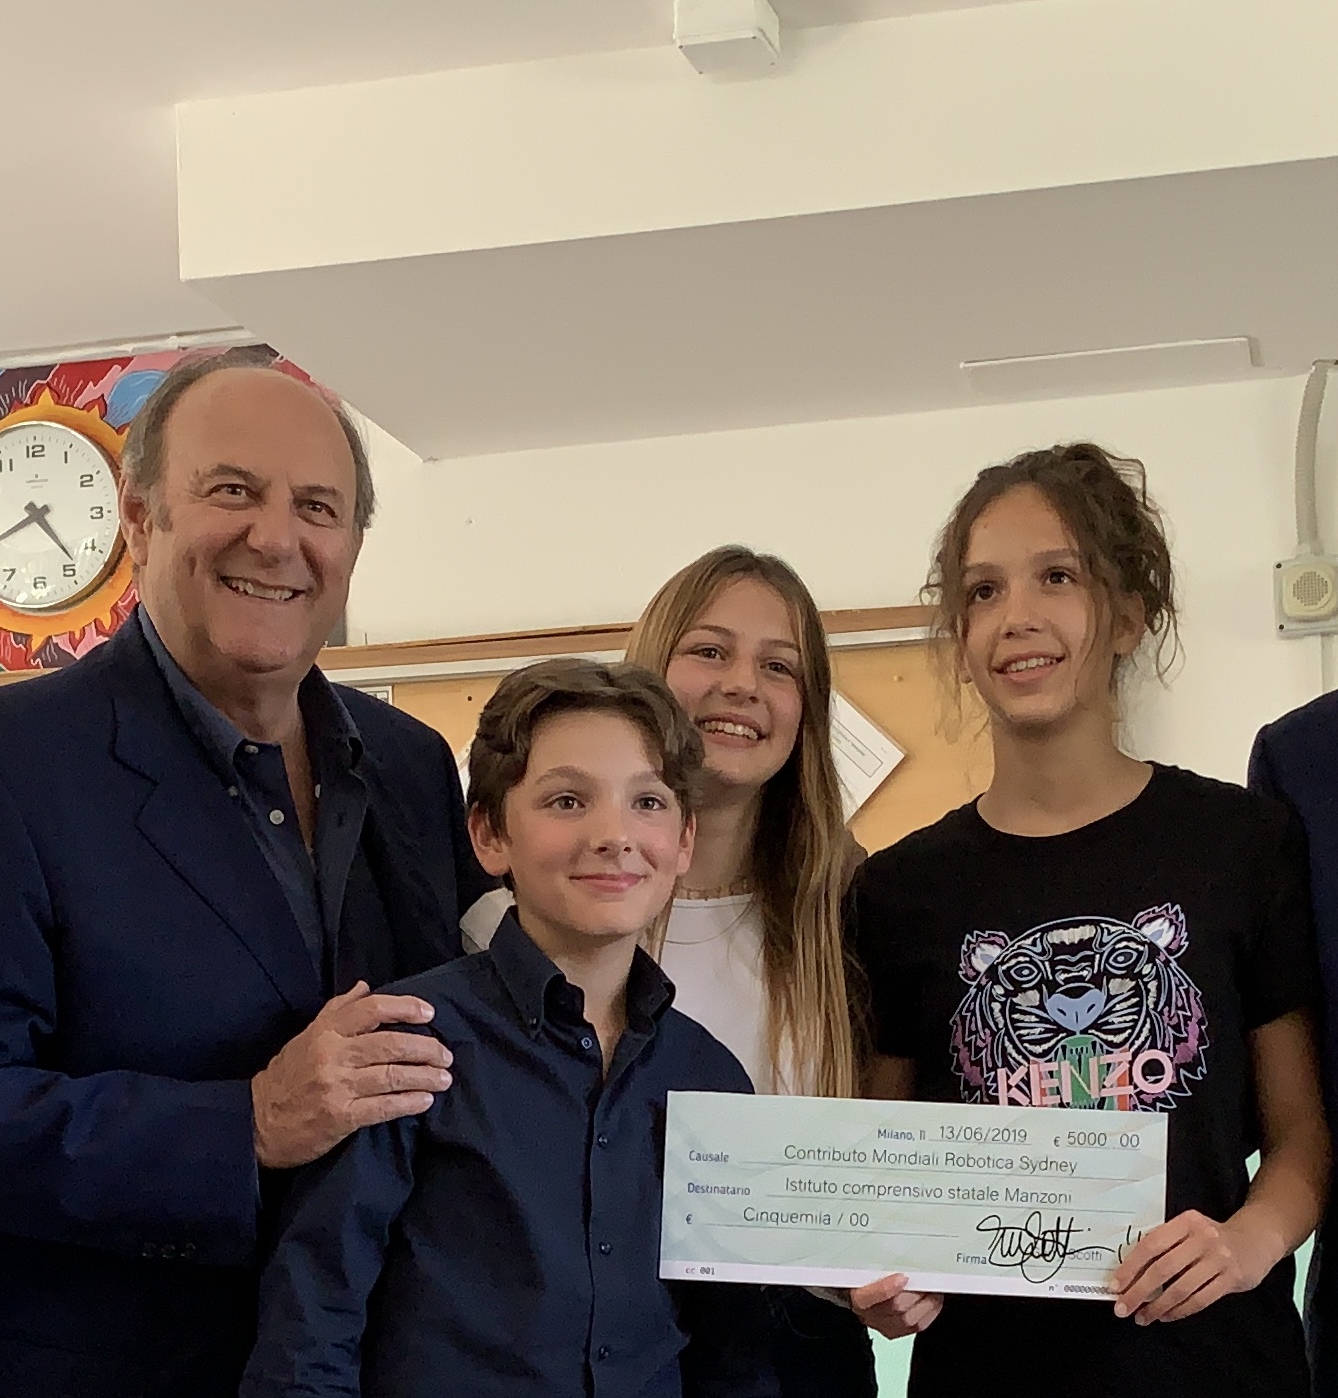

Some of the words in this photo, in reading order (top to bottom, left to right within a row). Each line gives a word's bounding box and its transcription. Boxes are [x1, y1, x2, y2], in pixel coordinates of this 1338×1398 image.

[26, 444, 46, 459] 12
[79, 473, 94, 488] 2
[89, 506, 104, 520] 3
[84, 538, 97, 551] 4
[3, 568, 16, 582] 7
[63, 564, 76, 578] 5
[33, 576, 47, 591] 6
[997, 1048, 1174, 1107] KENZO
[877, 1128, 916, 1142] Milano,
[938, 1125, 1028, 1144] 13/06/2019
[1067, 1131, 1108, 1147] 5000
[688, 1149, 730, 1163] Causale
[784, 1144, 867, 1163] Contributo
[872, 1148, 939, 1167] Mondiali
[944, 1152, 1014, 1170] Robotica
[1019, 1155, 1078, 1175] Sydney
[687, 1181, 751, 1196] Destinatario
[785, 1177, 838, 1195] Istituto
[842, 1182, 943, 1200] comprensivo
[947, 1185, 1000, 1202] statale
[1004, 1187, 1073, 1205] Manzoni
[743, 1206, 831, 1226] Cinquemila
[849, 1212, 870, 1228] 00
[956, 1253, 988, 1266] Firma
